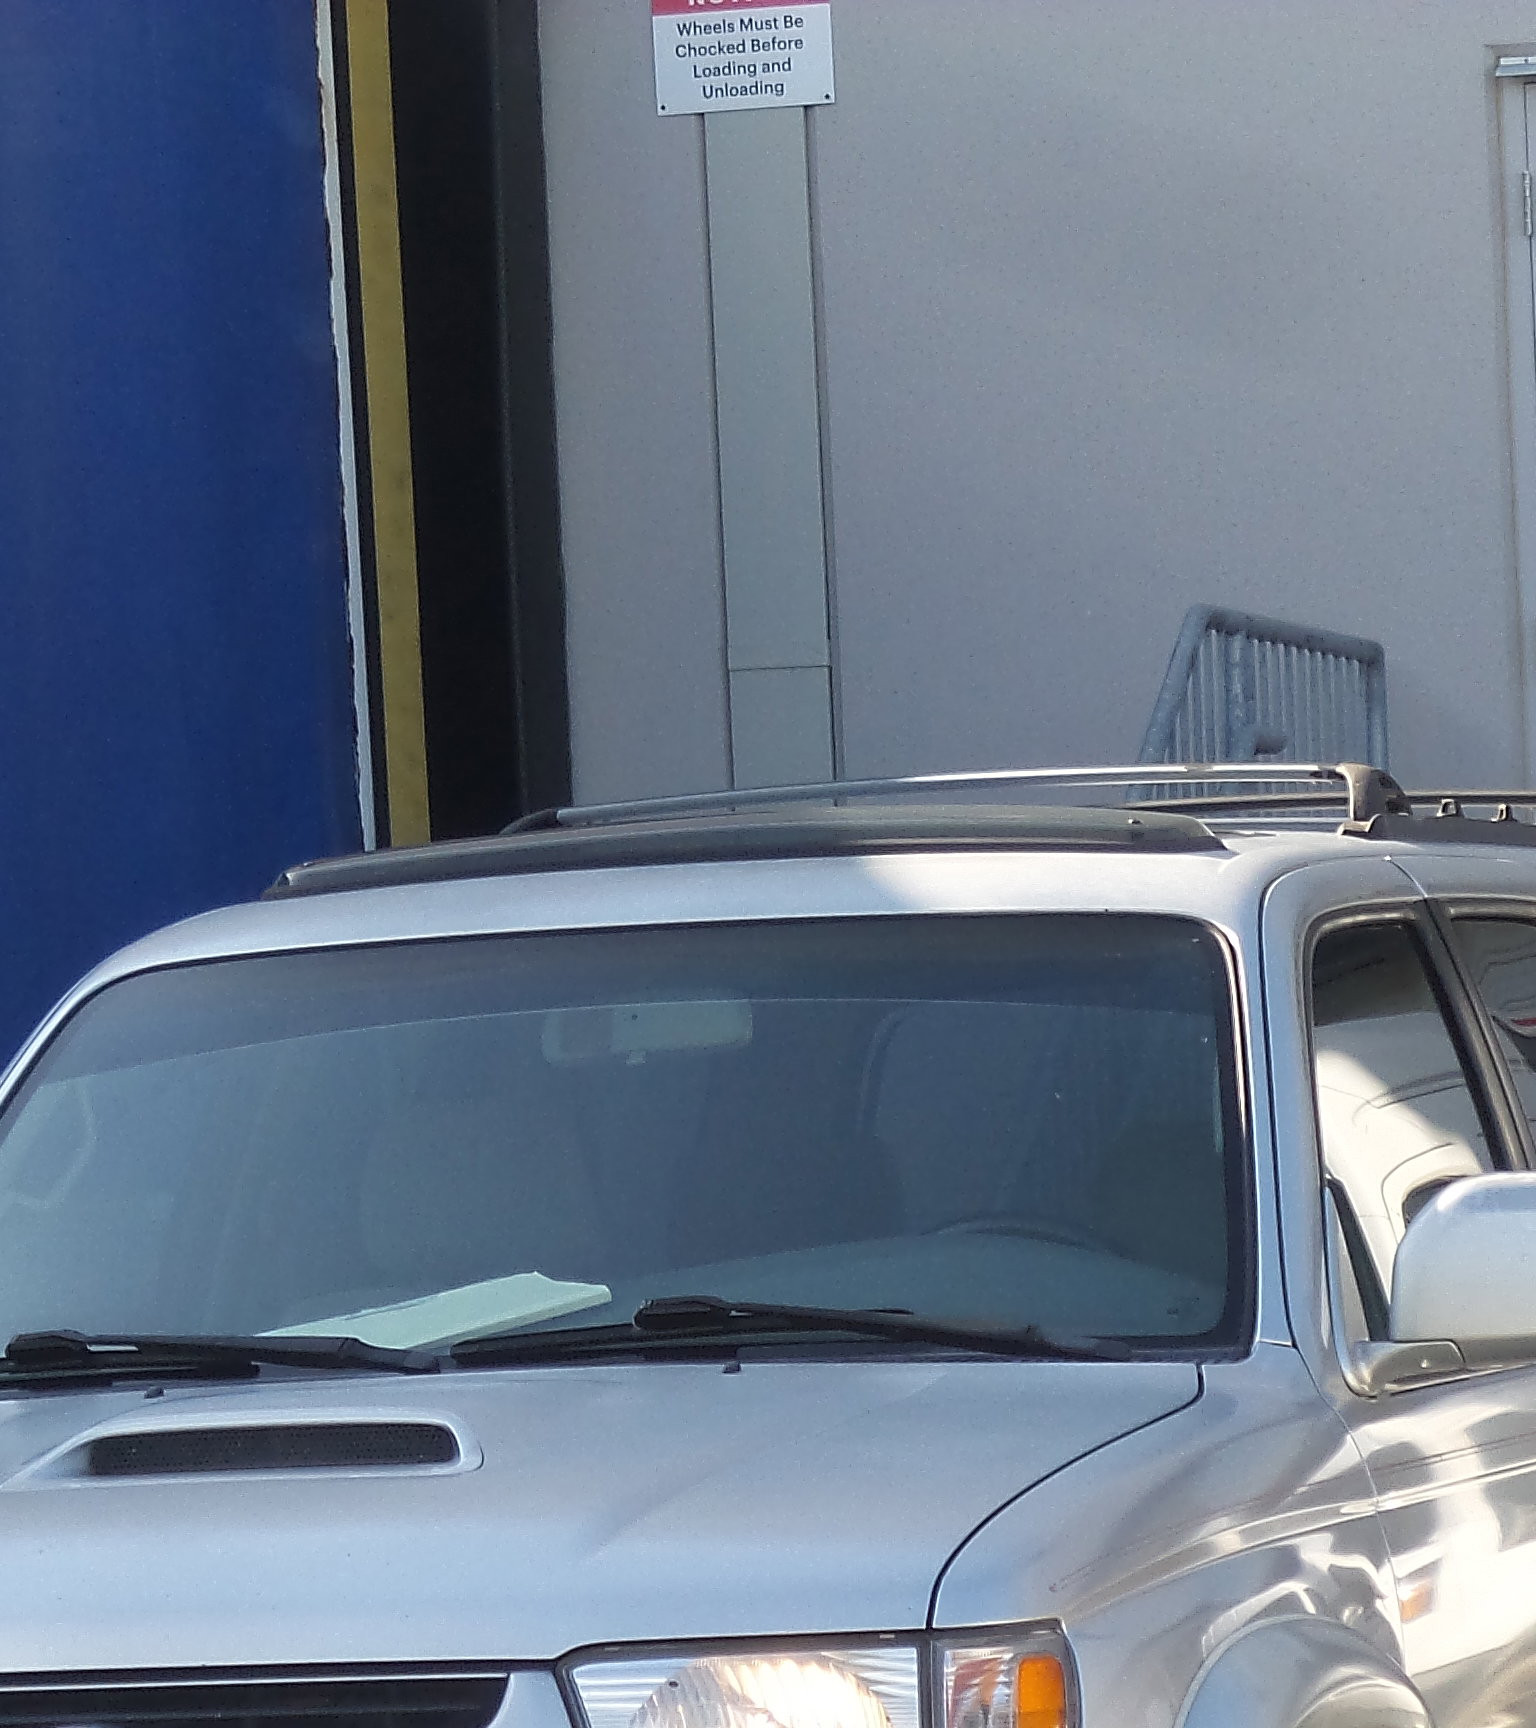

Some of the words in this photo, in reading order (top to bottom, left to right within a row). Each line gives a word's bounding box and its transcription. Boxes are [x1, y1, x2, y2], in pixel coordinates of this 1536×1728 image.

[676, 18, 735, 37] Wheels
[739, 16, 779, 33] Must
[783, 15, 804, 29] Be
[675, 39, 746, 58] Chocked
[751, 37, 804, 53] Before
[693, 61, 757, 79] Loading
[761, 58, 792, 74] and
[702, 80, 785, 99] Unloading
